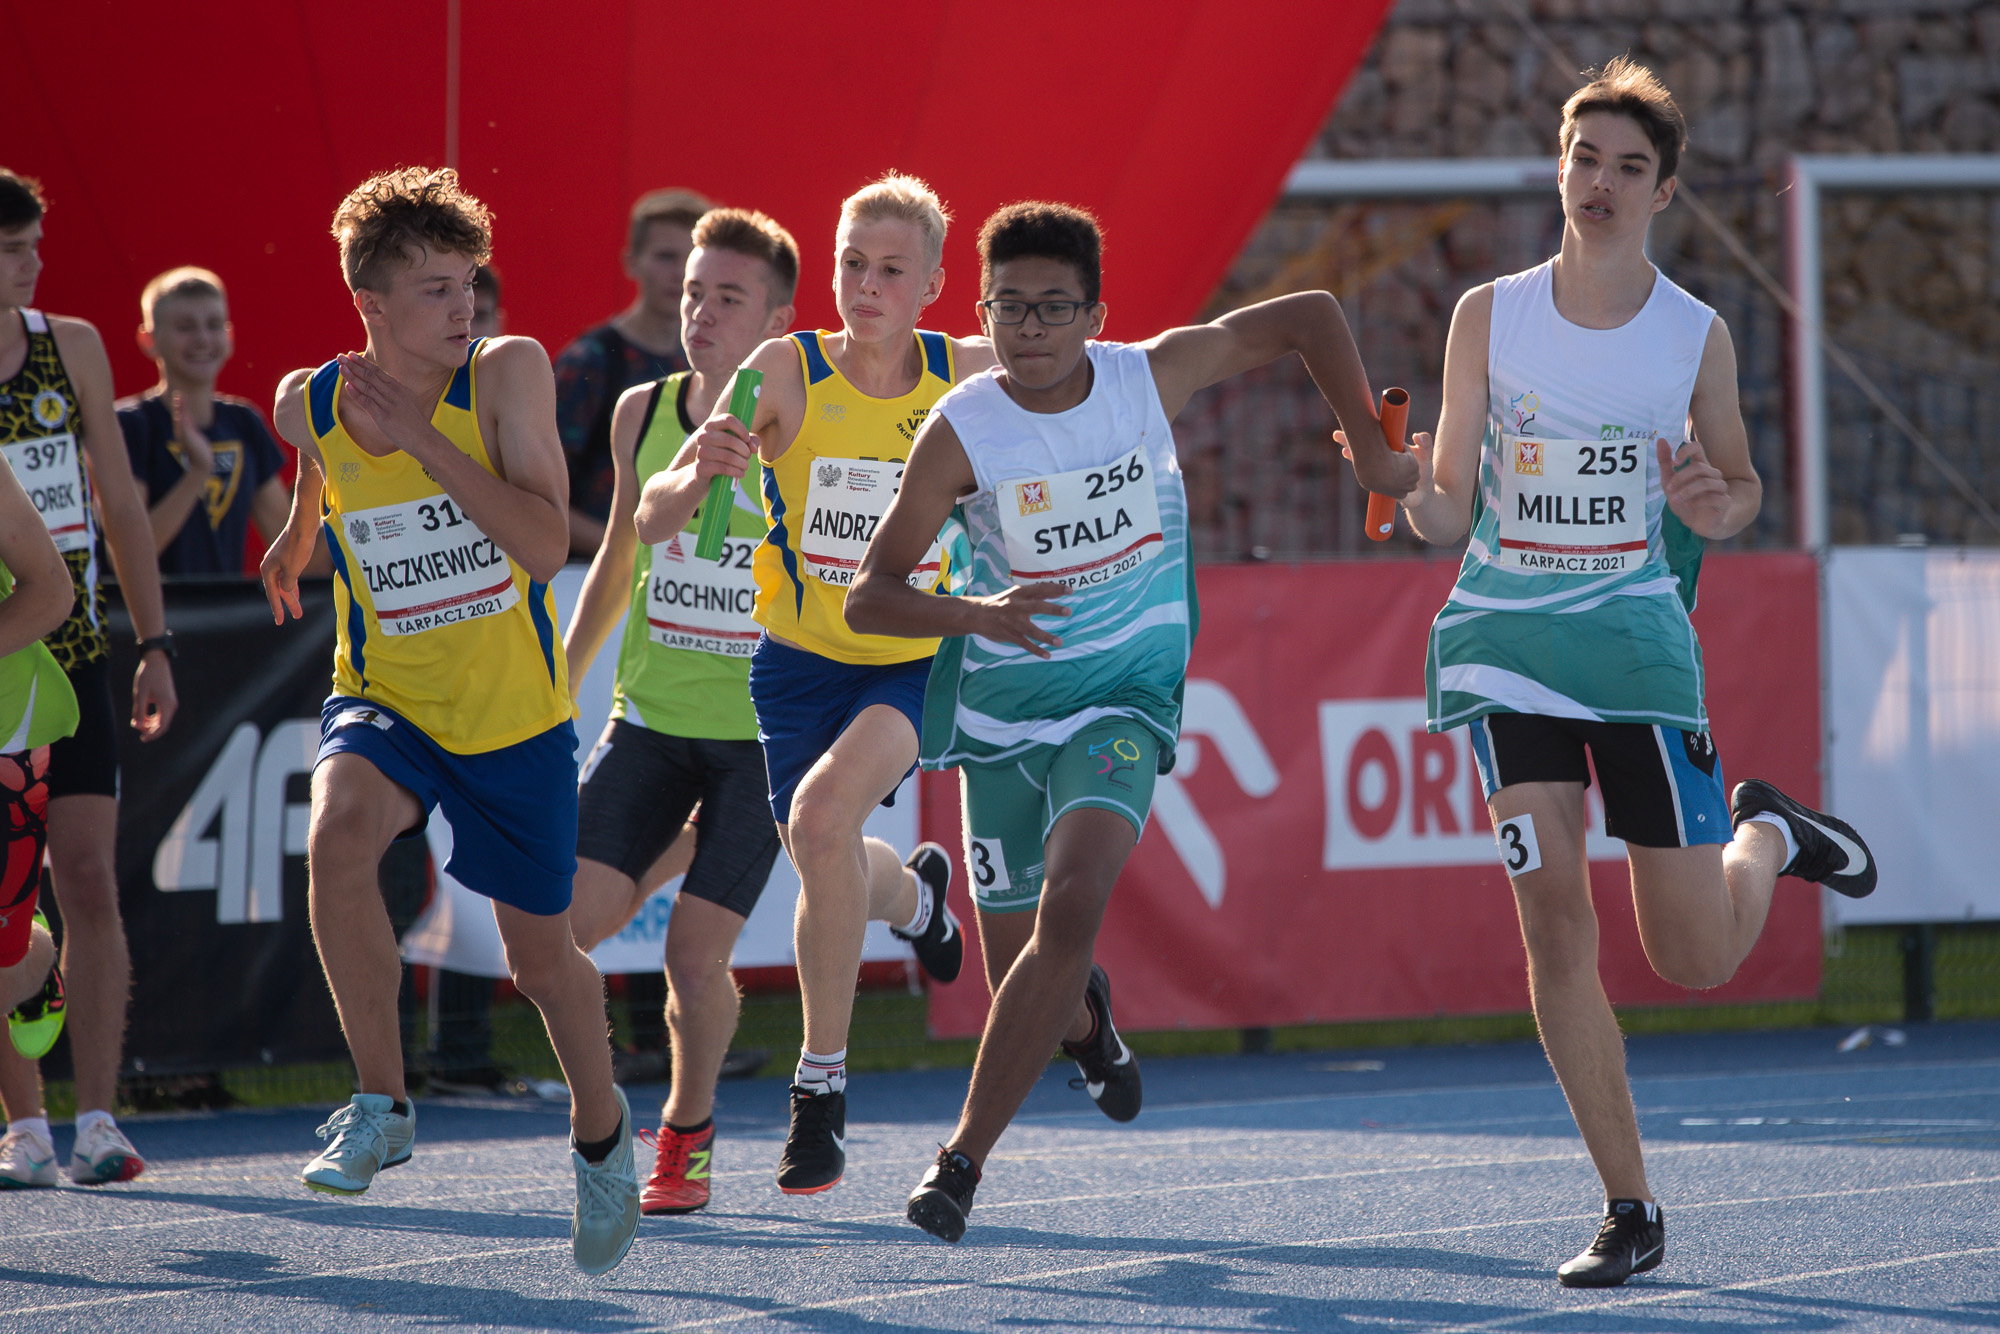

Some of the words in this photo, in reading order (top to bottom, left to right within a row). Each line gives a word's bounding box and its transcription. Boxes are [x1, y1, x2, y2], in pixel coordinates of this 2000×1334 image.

[24, 441, 69, 470] 397
[1577, 445, 1638, 475] 255
[848, 471, 871, 479] Kultury
[1085, 454, 1144, 500] 256
[27, 484, 76, 513] OREK
[1518, 493, 1626, 526] MILLER
[417, 500, 470, 532] 31
[809, 507, 885, 542] ANDRZ
[1034, 508, 1133, 555] STALA
[362, 538, 503, 593] ŻACZKIEWICZ
[718, 543, 758, 569] 92
[1113, 551, 1143, 576] 2021
[1520, 553, 1587, 571] KARPACZ
[1591, 556, 1625, 571] 2021
[396, 608, 466, 634] KARPACZ
[467, 598, 502, 618] 2021
[661, 632, 722, 653] KARPACZ
[152, 718, 320, 925] 4F
[1501, 823, 1529, 871] 3
[971, 841, 996, 887] 3
